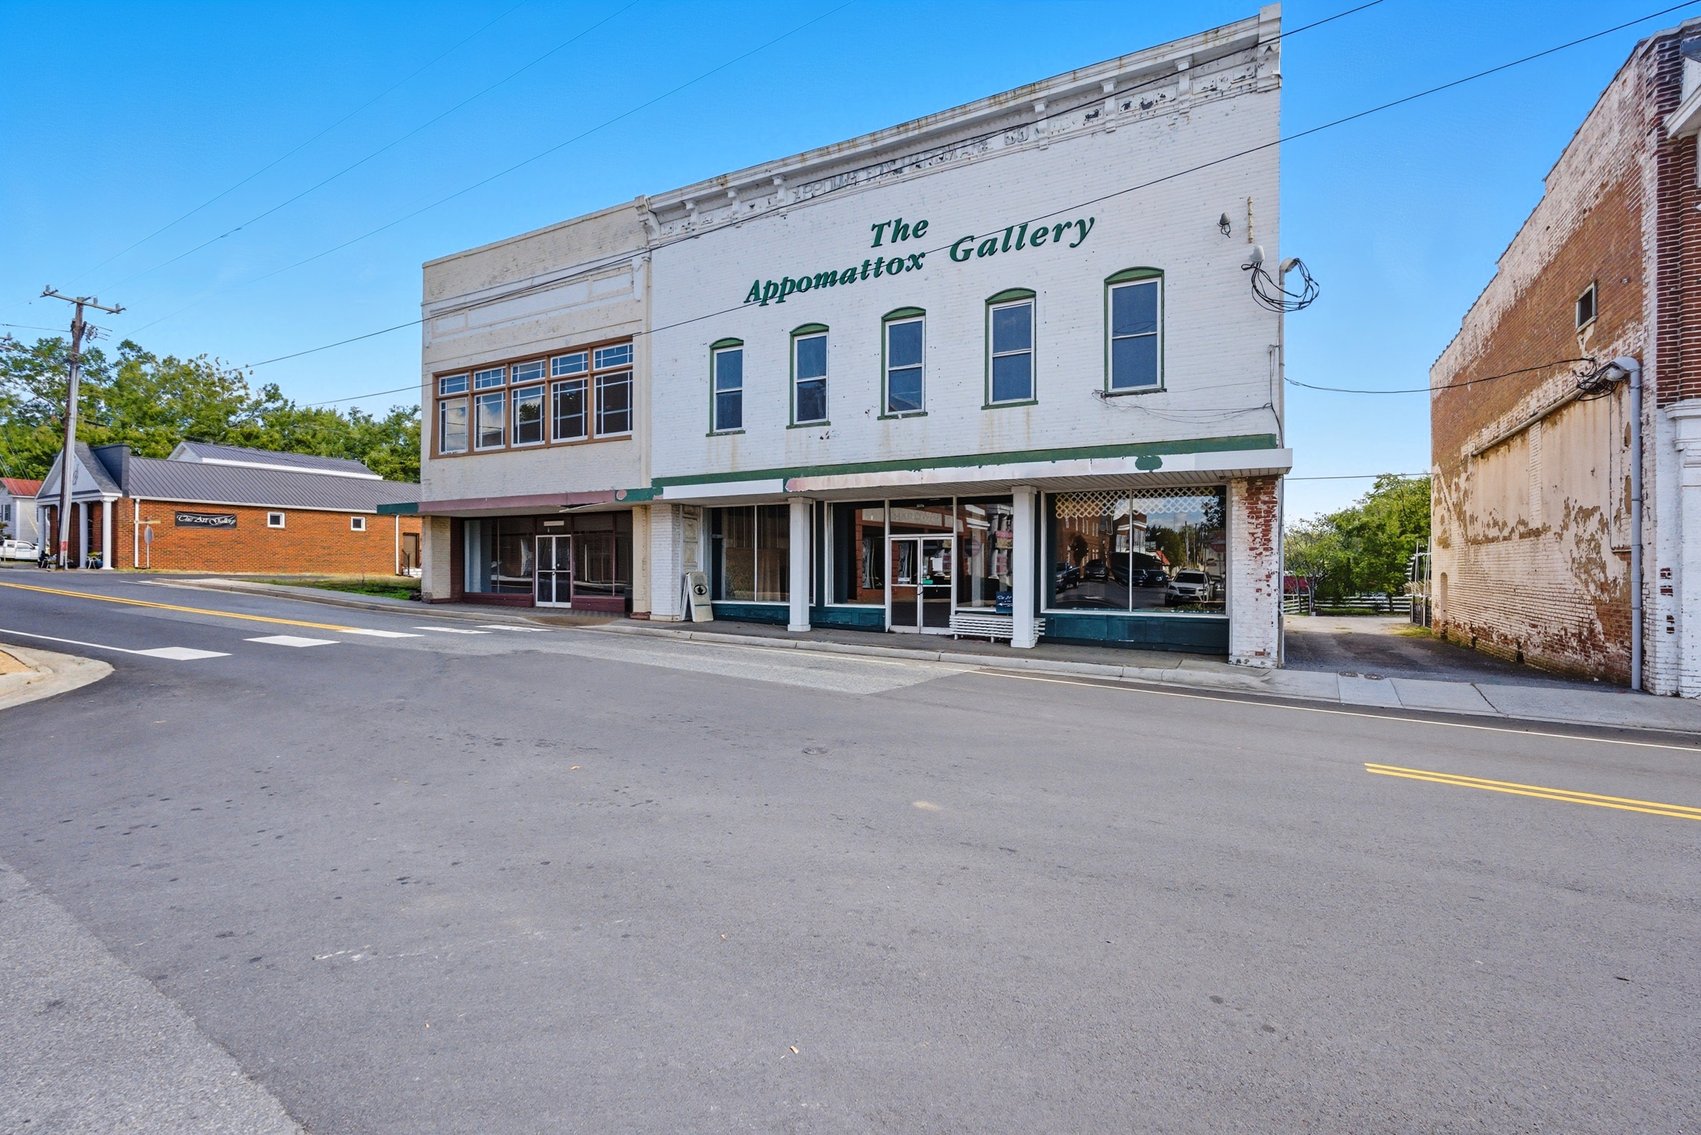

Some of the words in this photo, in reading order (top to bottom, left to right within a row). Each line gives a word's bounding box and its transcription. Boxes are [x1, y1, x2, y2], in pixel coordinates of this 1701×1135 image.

[743, 251, 926, 306] Appomattox
[950, 216, 1095, 262] Gallery
[871, 217, 929, 248] The
